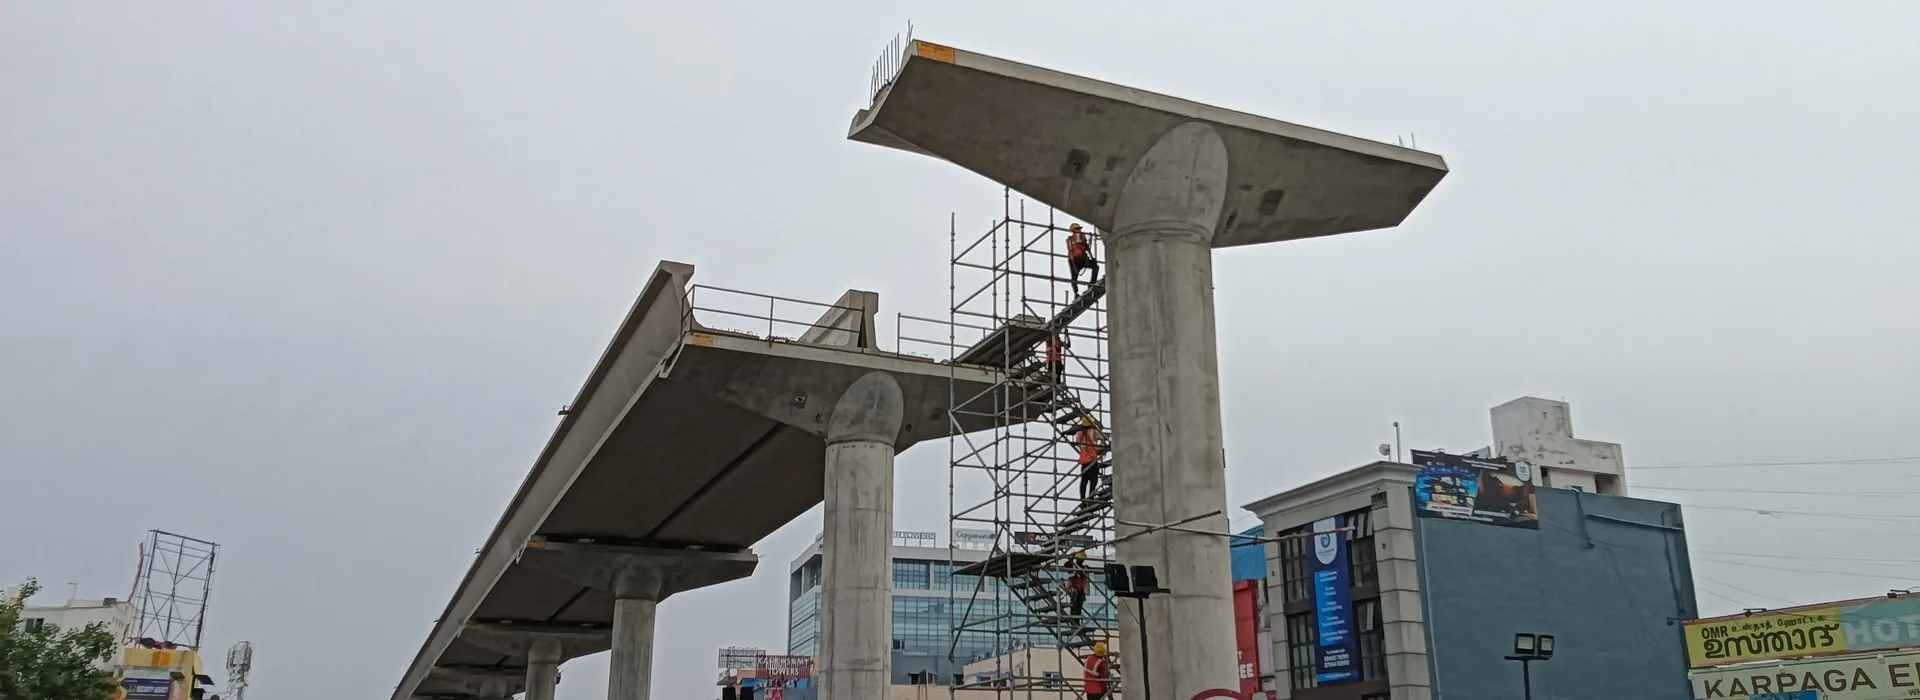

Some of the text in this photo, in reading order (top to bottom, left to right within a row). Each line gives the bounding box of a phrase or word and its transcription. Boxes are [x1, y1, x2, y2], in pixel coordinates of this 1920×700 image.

[1701, 625, 1729, 639] OMR
[1703, 623, 1840, 659] ഉസ്താദ്
[768, 667, 800, 676] TOWERS
[1704, 667, 1878, 699] KARPAGA
